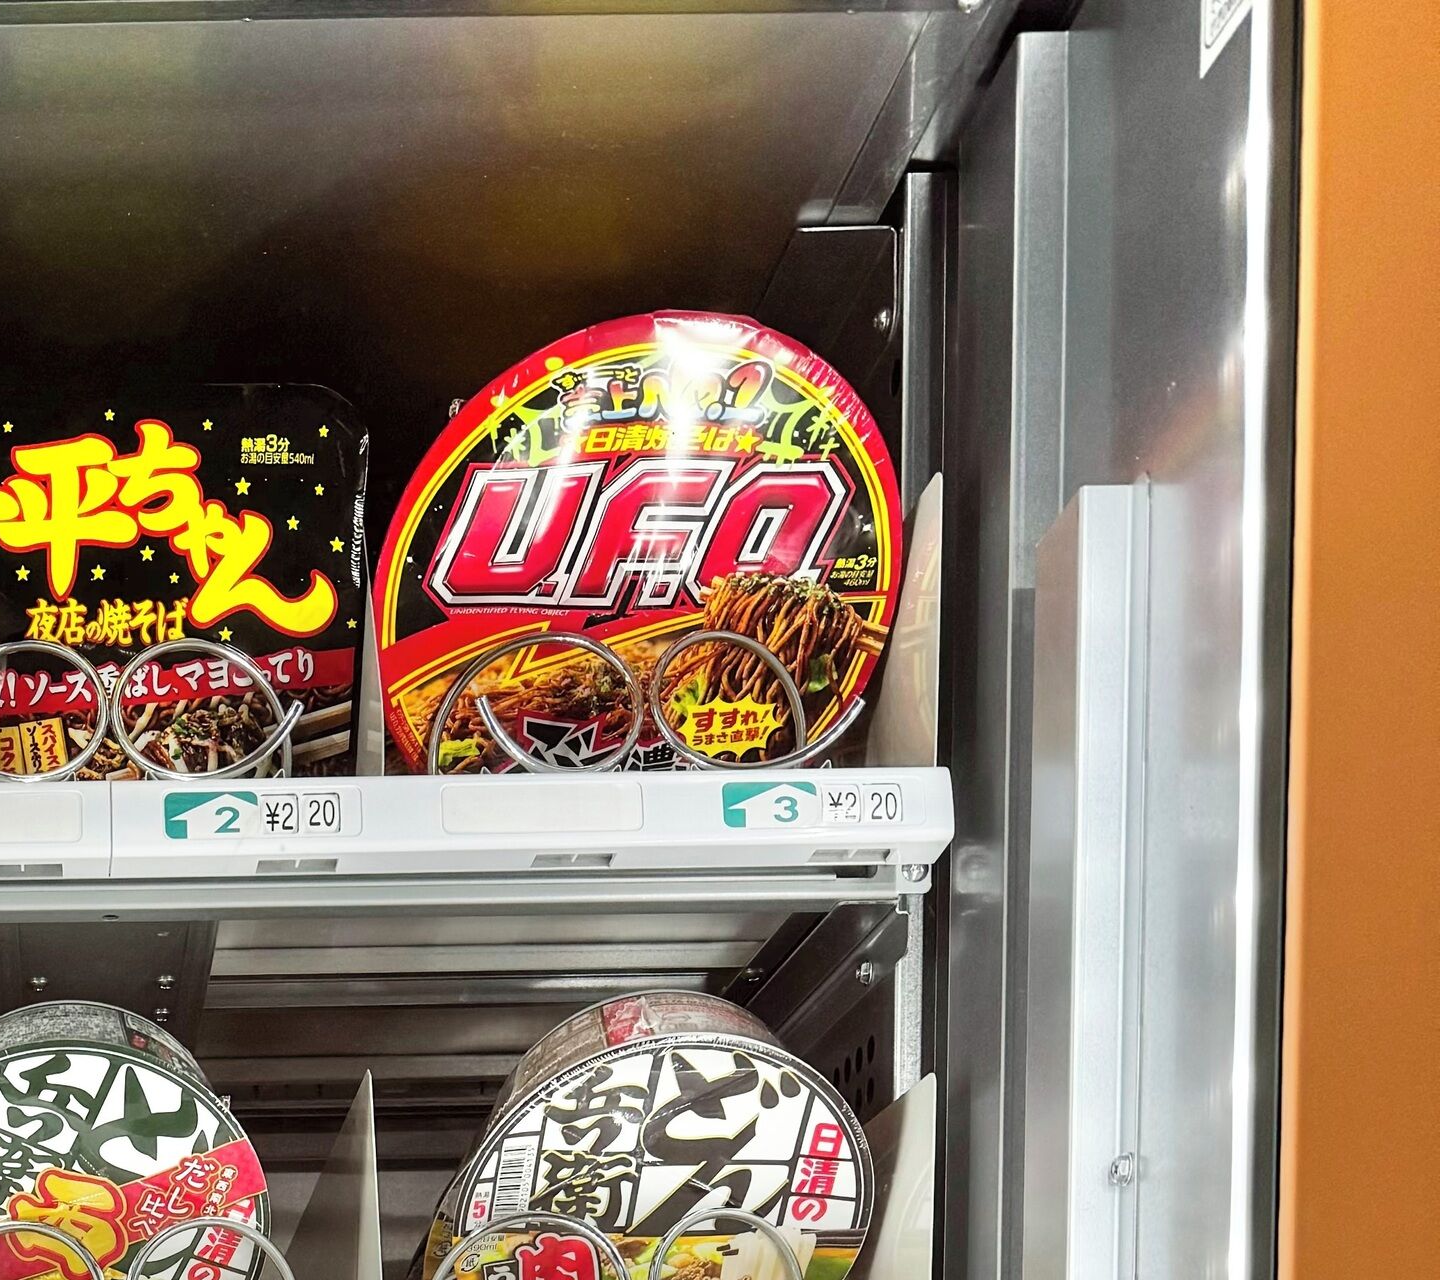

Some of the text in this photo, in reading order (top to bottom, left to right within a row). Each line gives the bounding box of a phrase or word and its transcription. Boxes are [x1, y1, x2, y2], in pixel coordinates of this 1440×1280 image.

[241, 434, 291, 452] 熱湯3分
[240, 452, 315, 465] お湯の目安量540ml
[25, 598, 189, 648] 夜店の焼そば
[450, 607, 571, 617] UNIDENTIFIED FLYING OBJECT
[691, 707, 772, 732] すすれ!
[215, 806, 242, 834] 2
[773, 796, 800, 824] 3
[790, 1122, 844, 1224] 日清の
